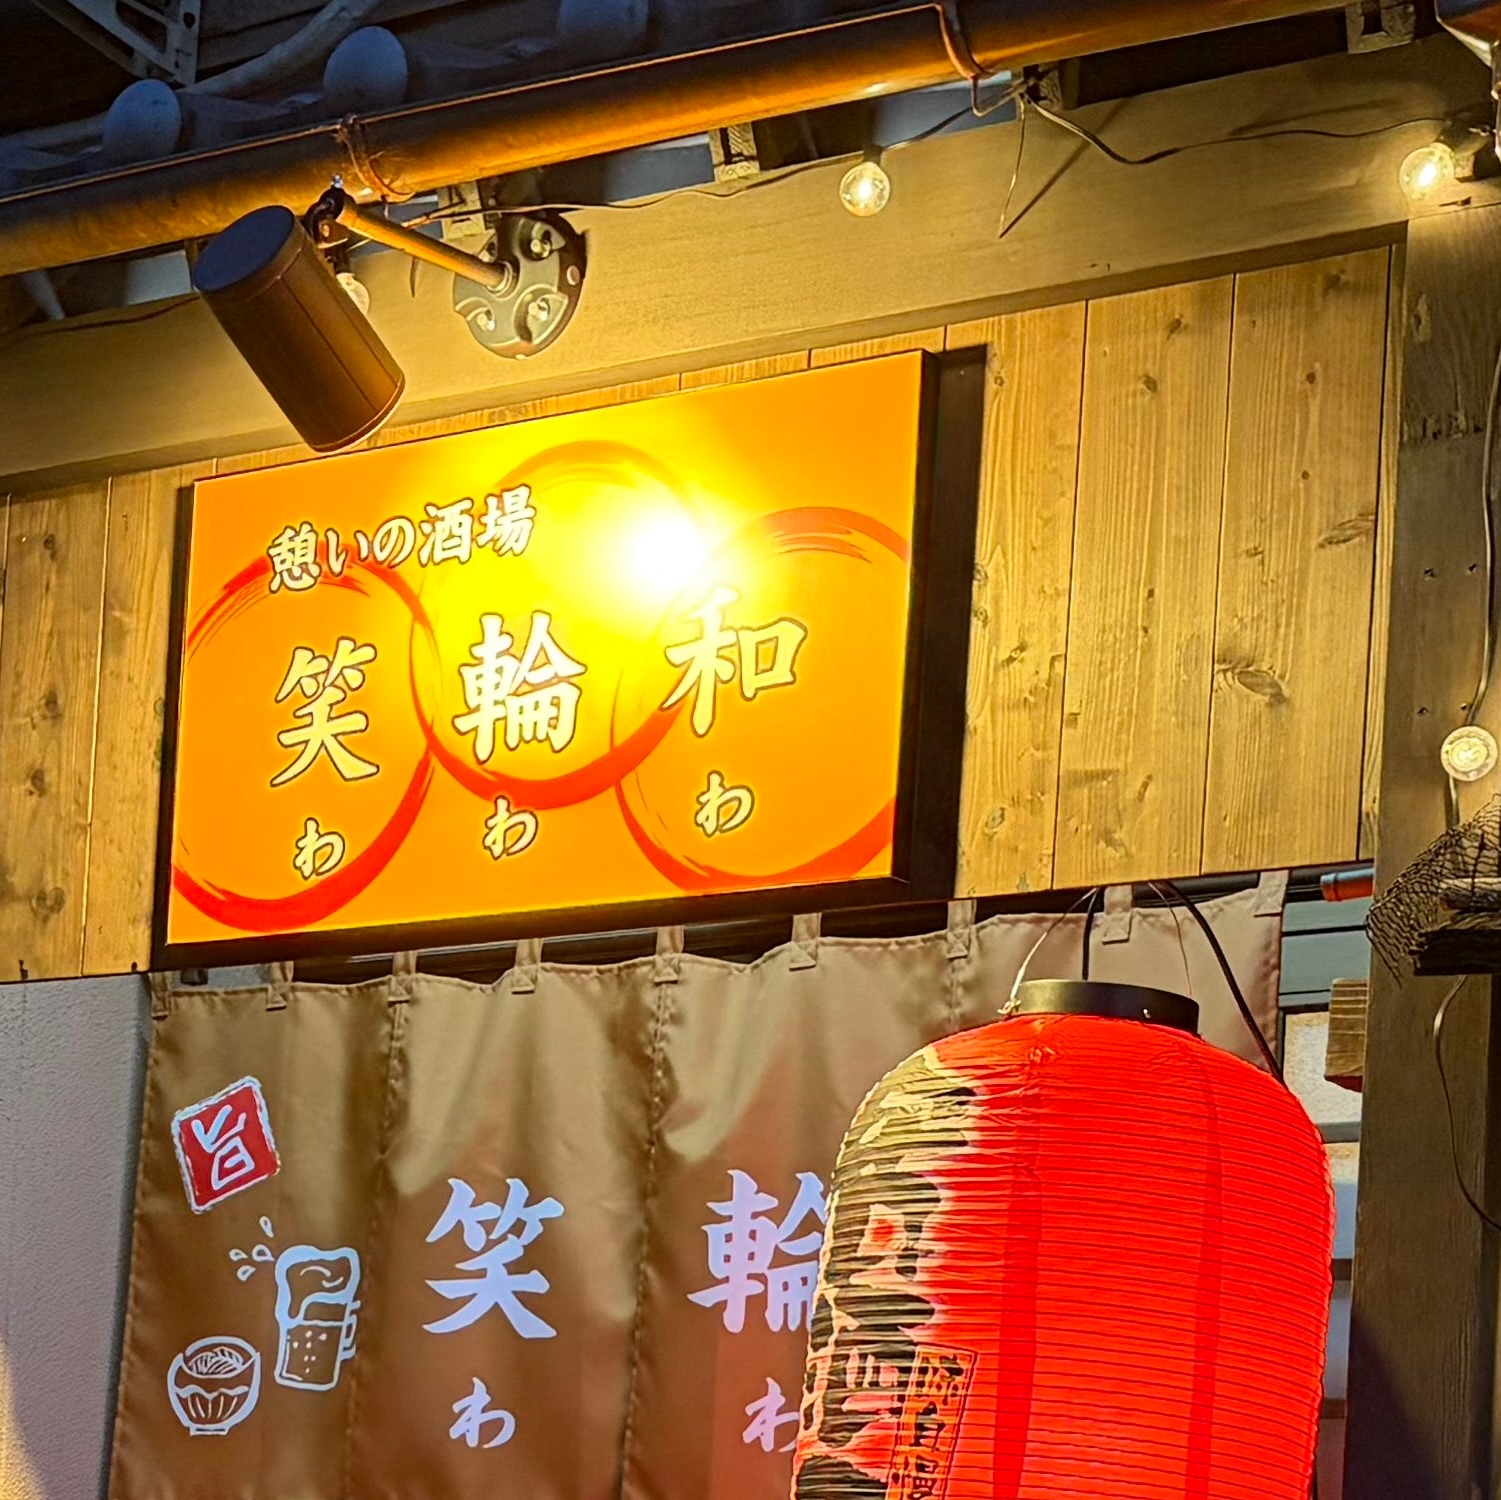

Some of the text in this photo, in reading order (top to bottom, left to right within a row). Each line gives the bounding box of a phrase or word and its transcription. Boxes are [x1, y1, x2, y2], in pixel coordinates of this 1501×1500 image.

[267, 484, 537, 595] 憩いの酒場
